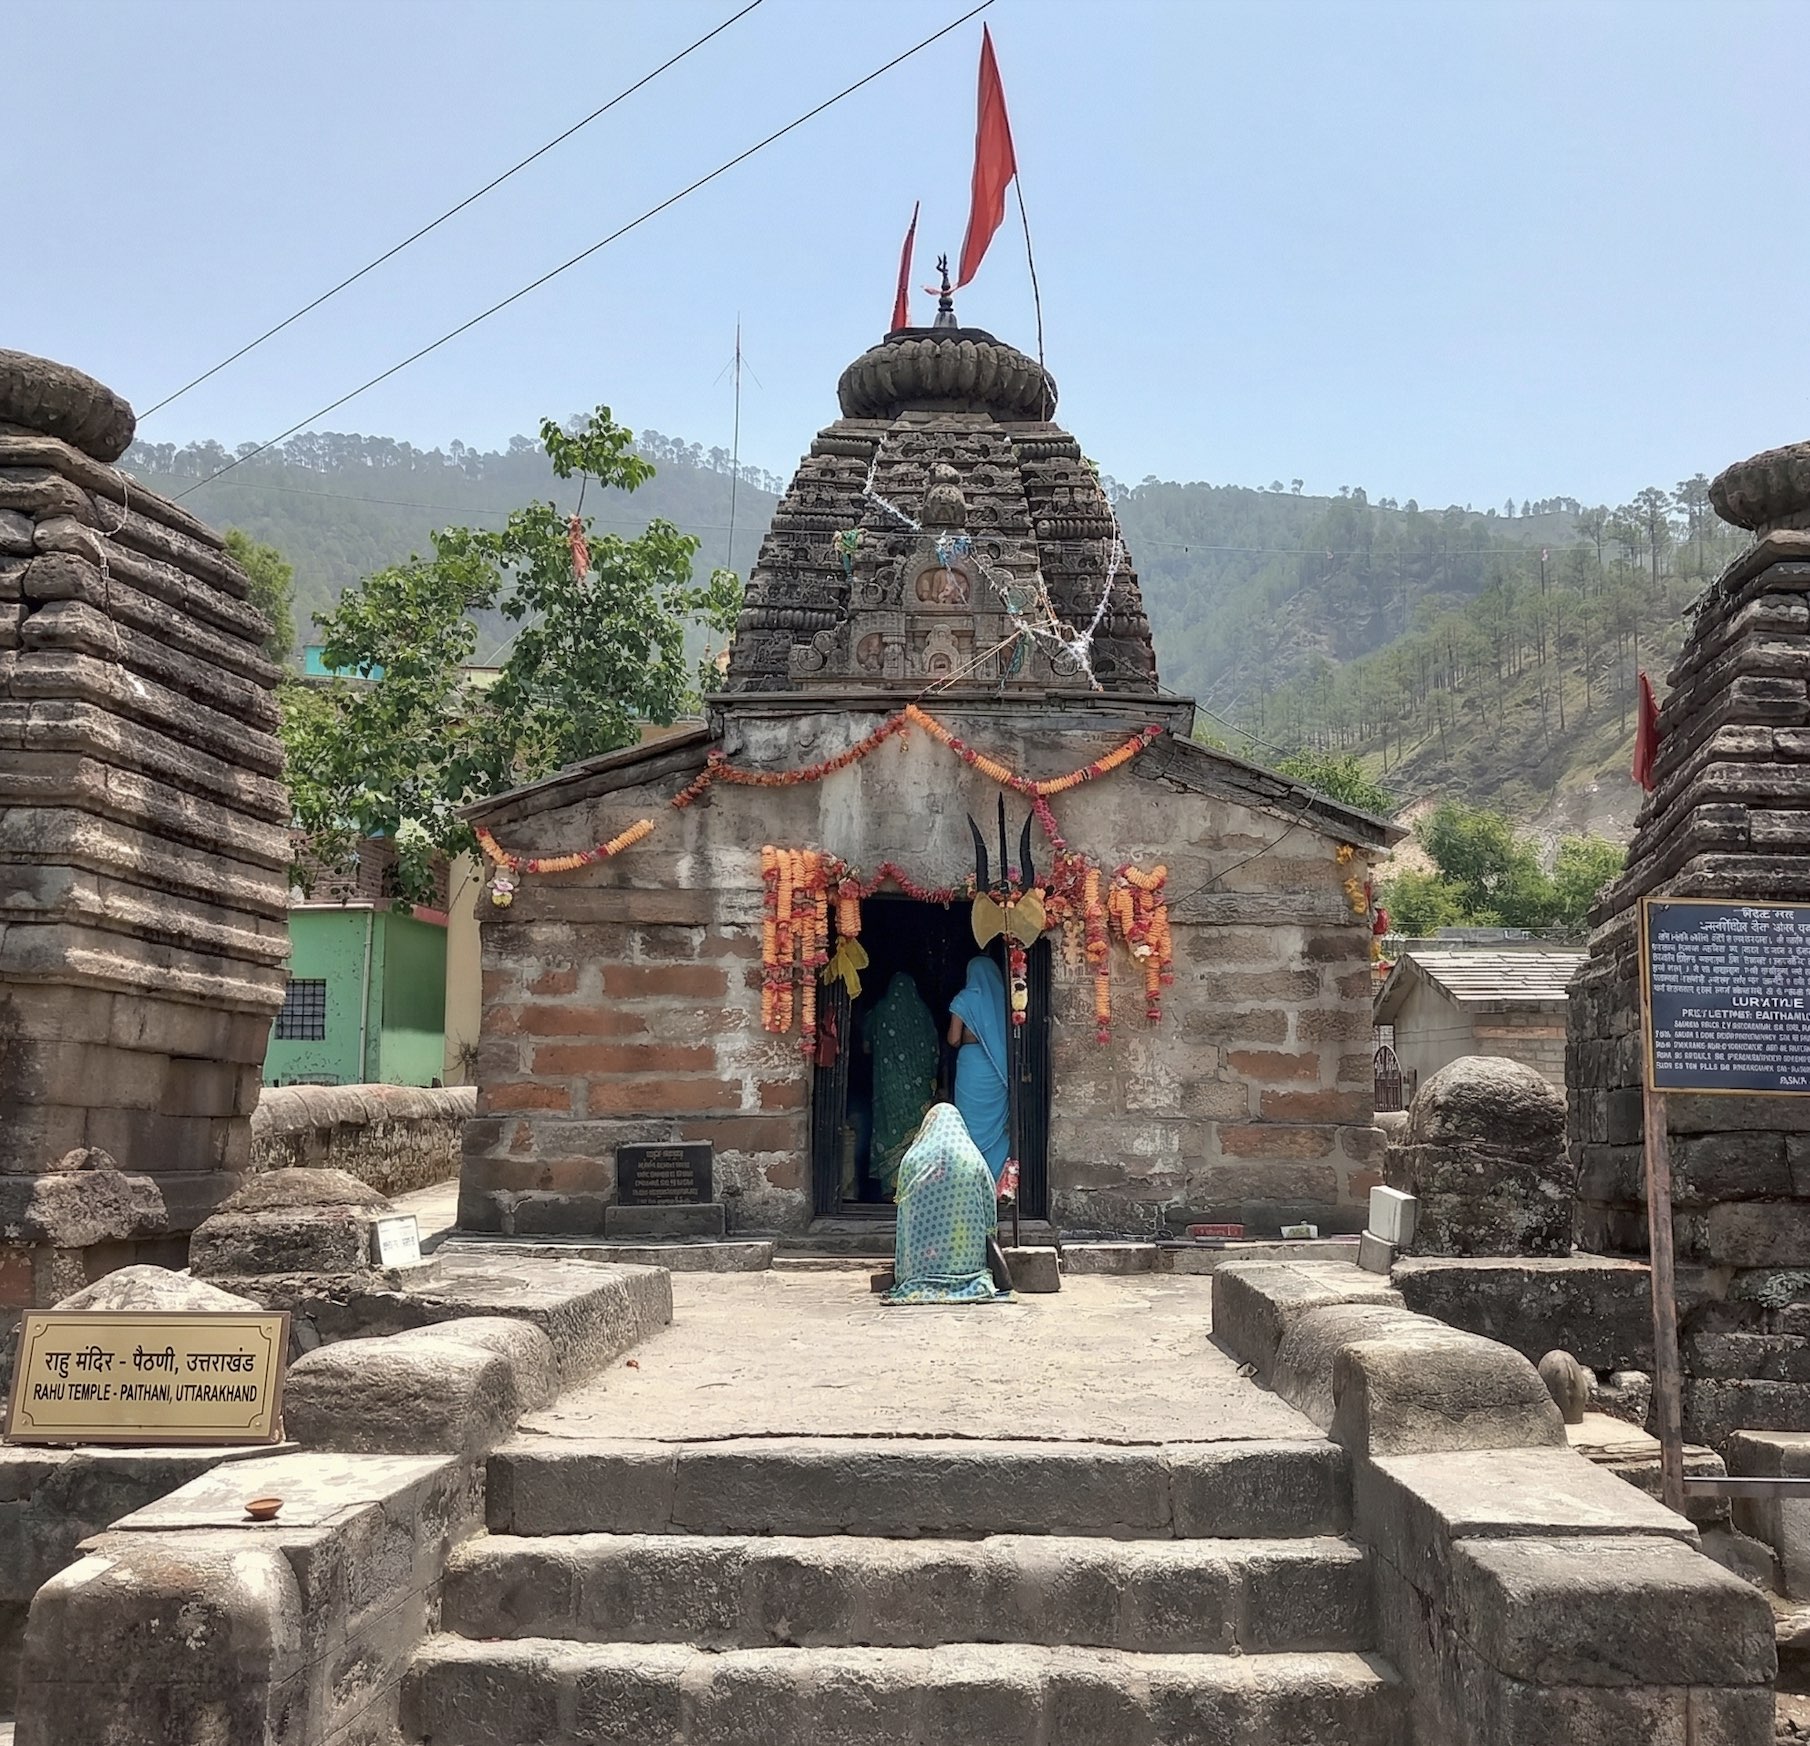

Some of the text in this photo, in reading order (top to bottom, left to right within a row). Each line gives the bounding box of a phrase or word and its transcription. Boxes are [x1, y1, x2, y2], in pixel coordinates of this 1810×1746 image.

[45, 1352, 71, 1378] राहु
[76, 1345, 115, 1372] मंदिर
[133, 1345, 179, 1375] पैठणी,
[186, 1347, 256, 1372] उत्तराखंड
[33, 1383, 66, 1400] RAHU
[68, 1383, 112, 1401] TEMPLE
[120, 1384, 173, 1404] PAITHANI,
[176, 1384, 257, 1402] UTTARAKHAND
